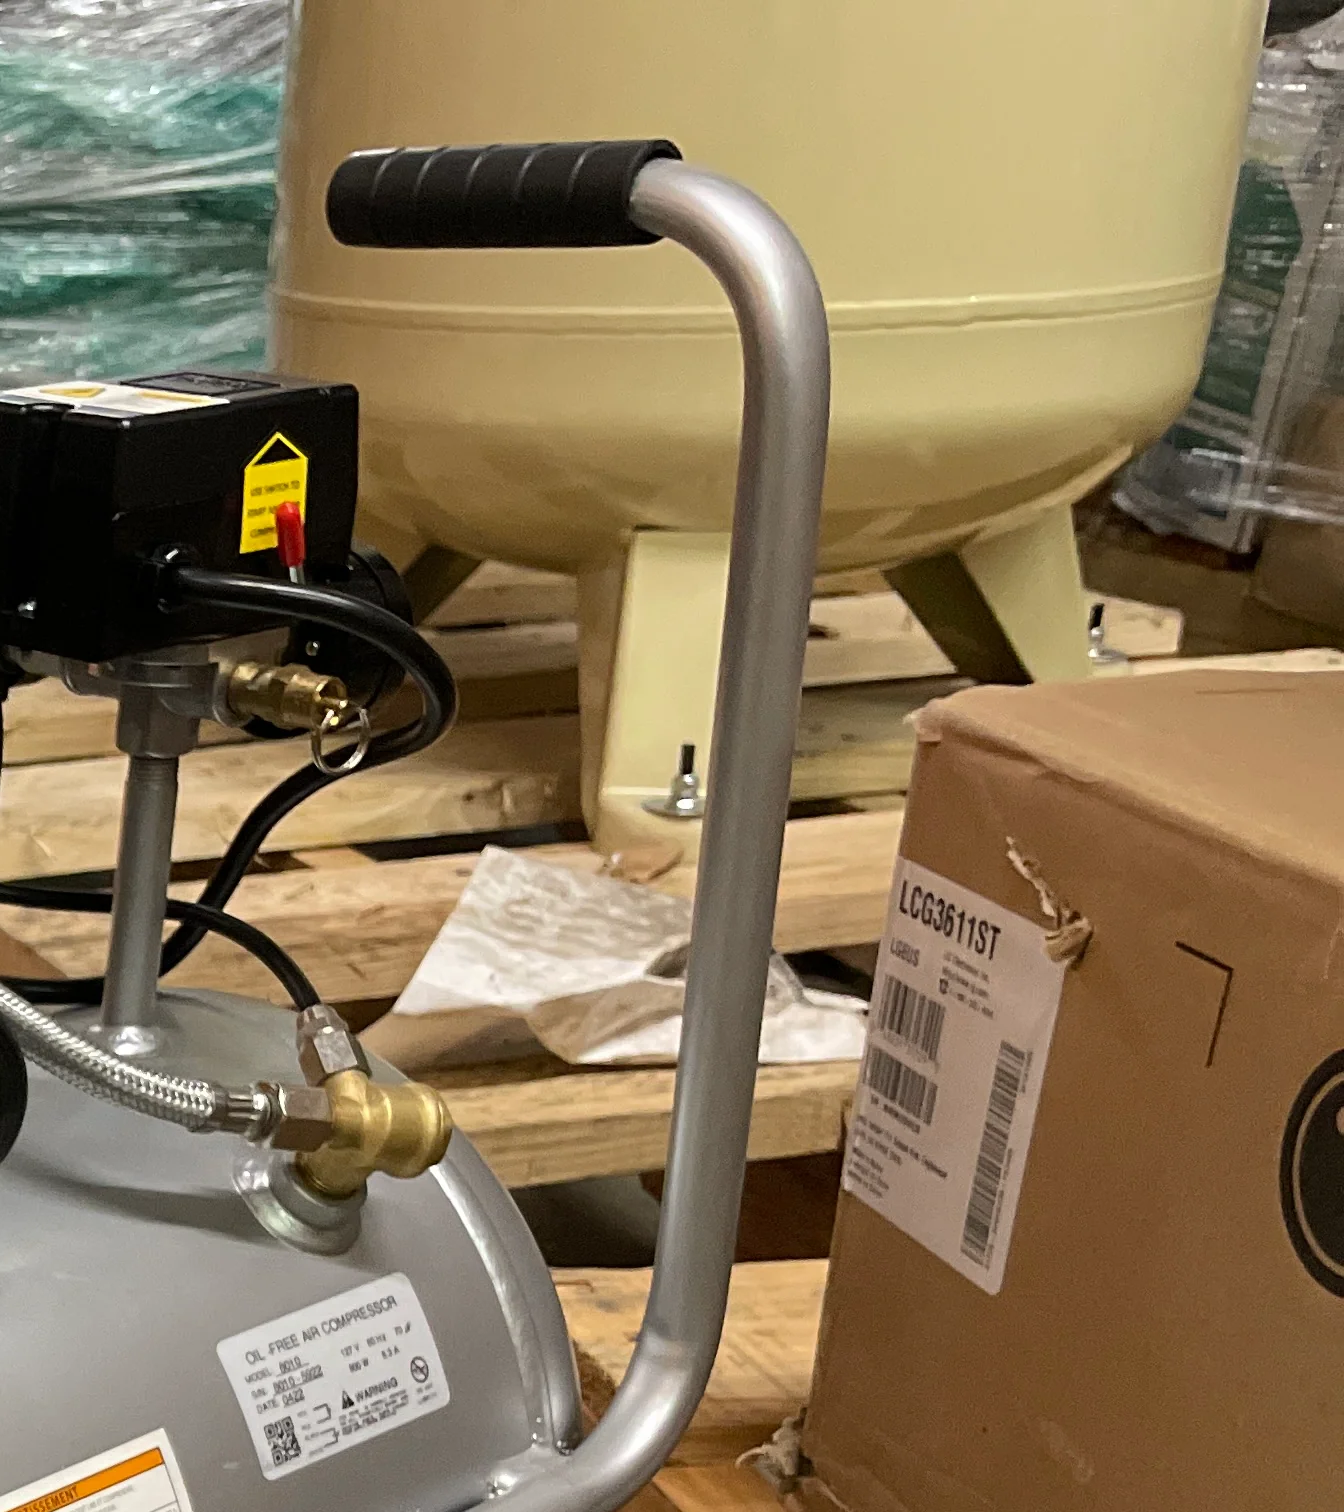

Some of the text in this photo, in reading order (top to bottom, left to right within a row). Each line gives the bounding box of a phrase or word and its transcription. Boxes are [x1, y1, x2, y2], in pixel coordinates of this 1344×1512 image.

[899, 880, 1001, 961] LCG3611ST
[302, 1326, 321, 1342] AIR
[321, 1295, 397, 1334] COMPRESSOR
[355, 1377, 398, 1402] WARNING
